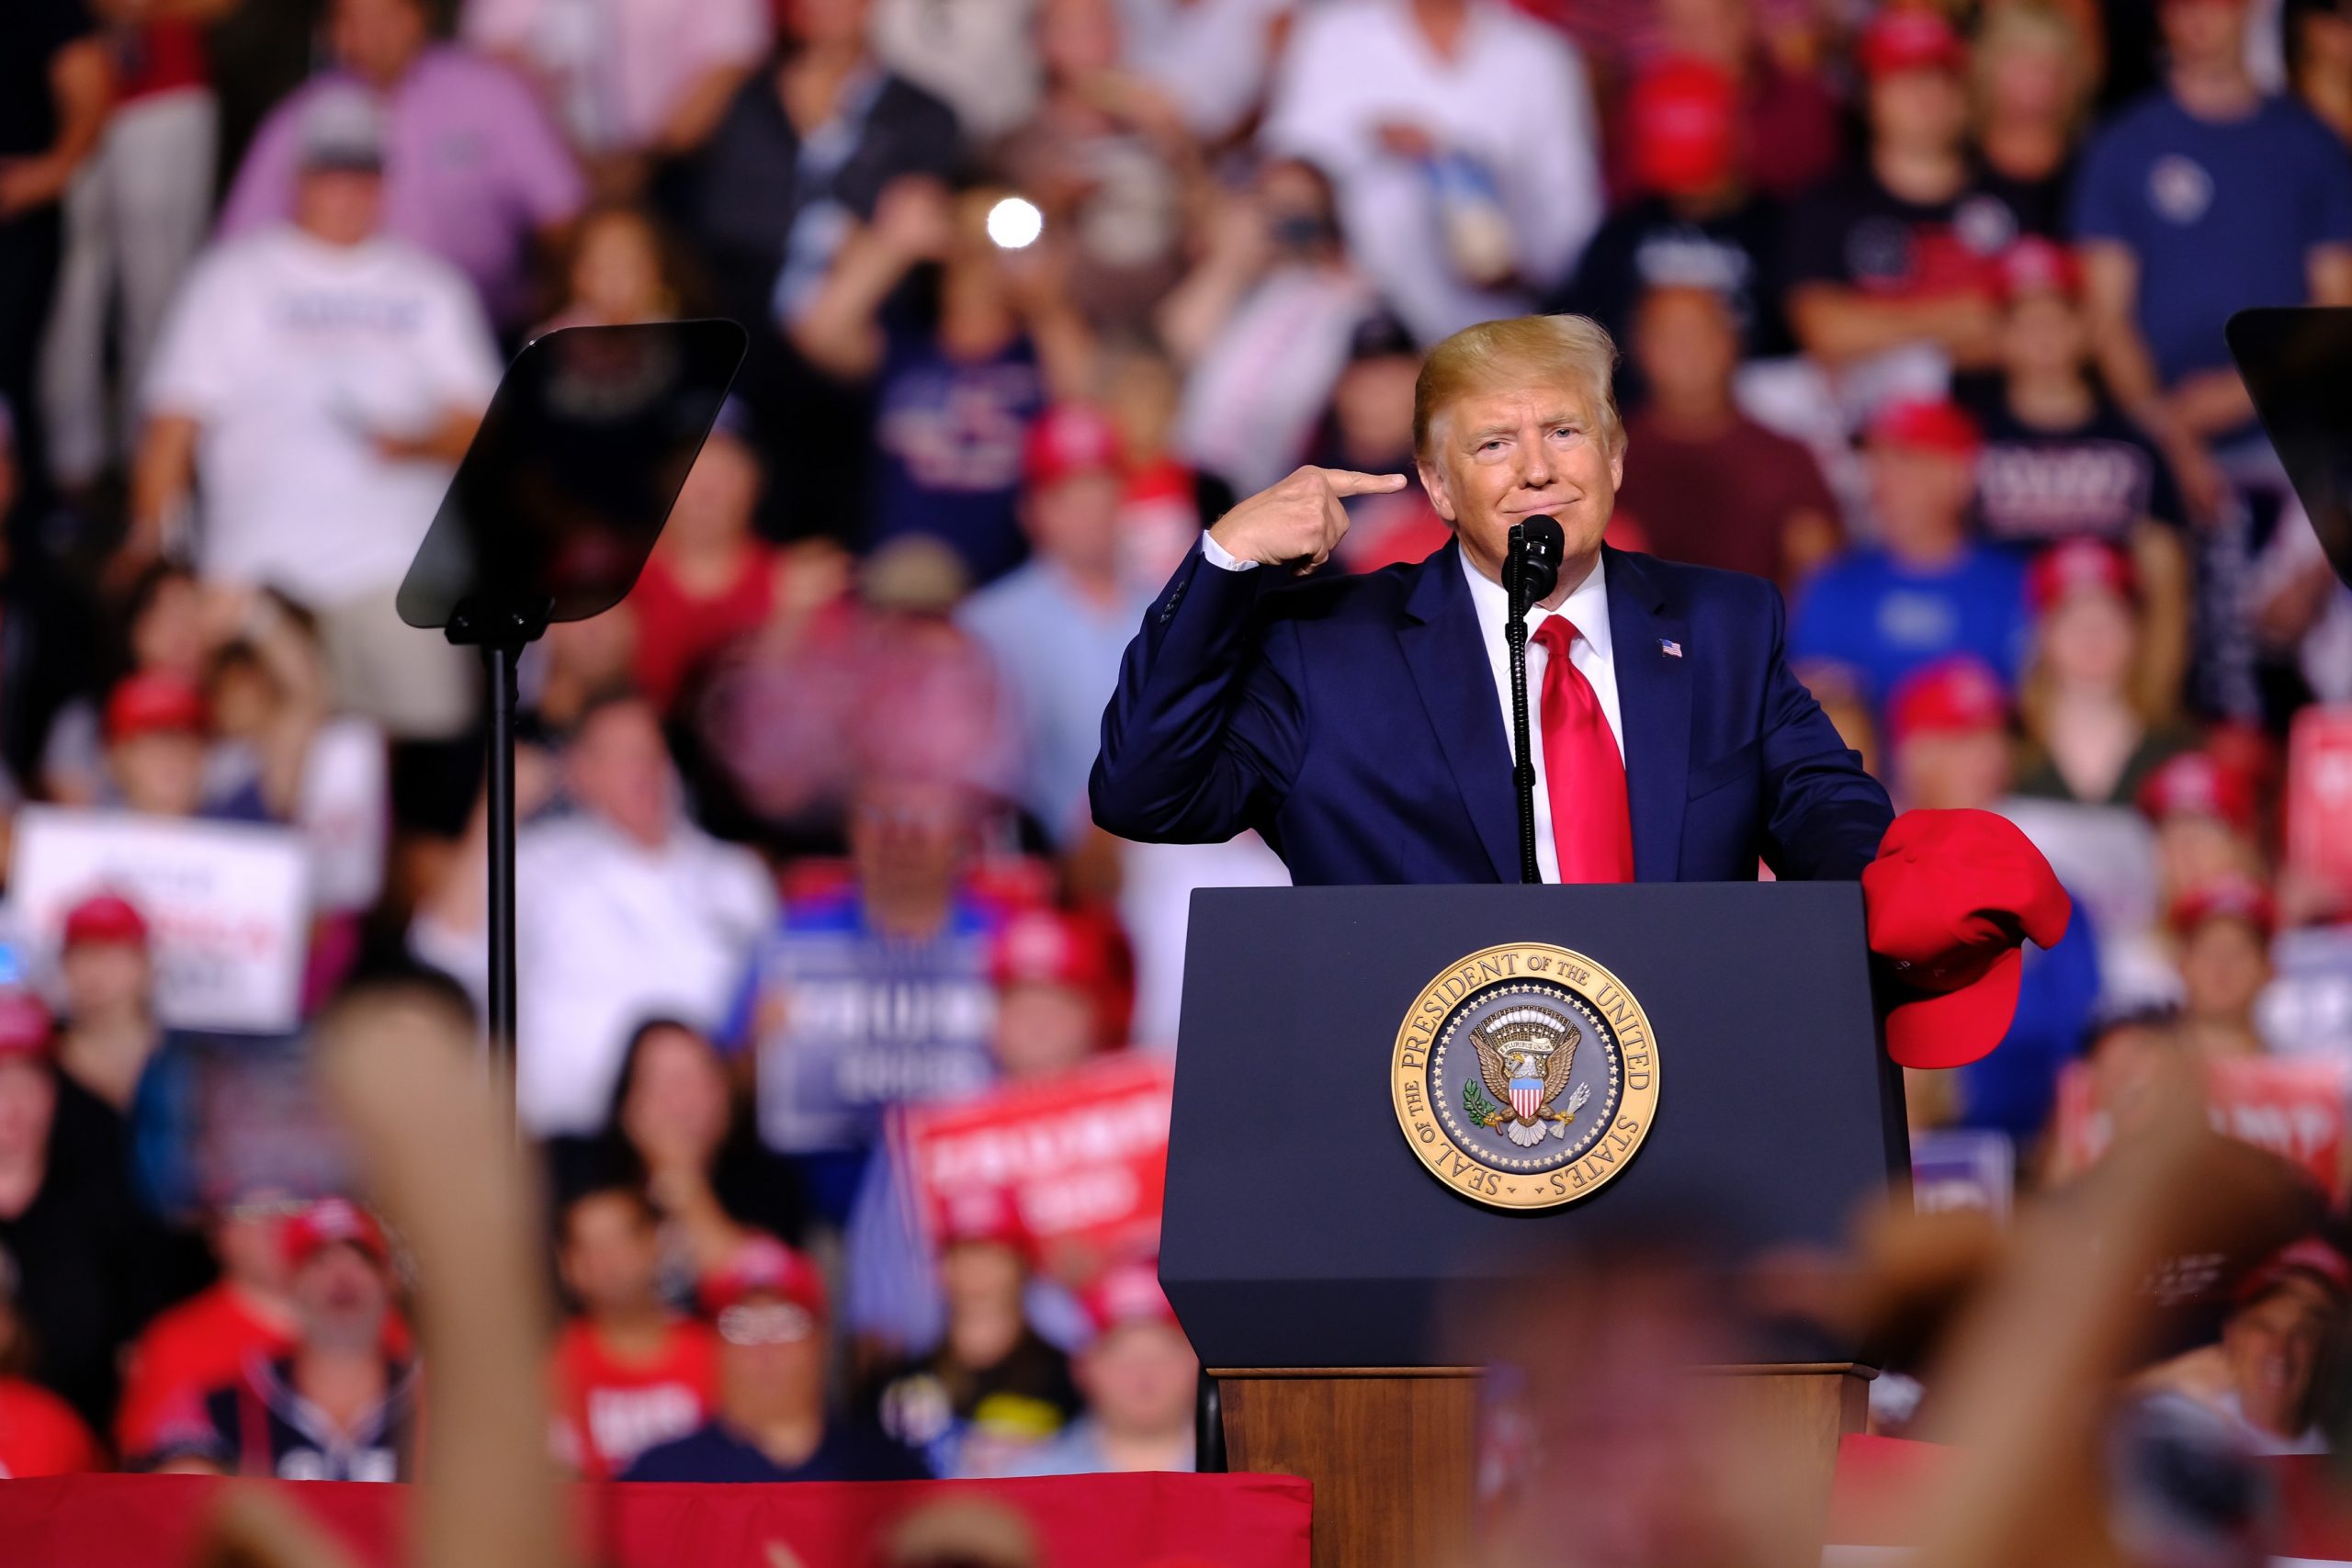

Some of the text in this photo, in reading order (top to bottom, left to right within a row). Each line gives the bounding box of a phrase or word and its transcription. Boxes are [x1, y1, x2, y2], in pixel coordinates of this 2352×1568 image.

[1402, 953, 1650, 1196] SEAL OF THE PRESIDENT OF THE UNITED STATES
